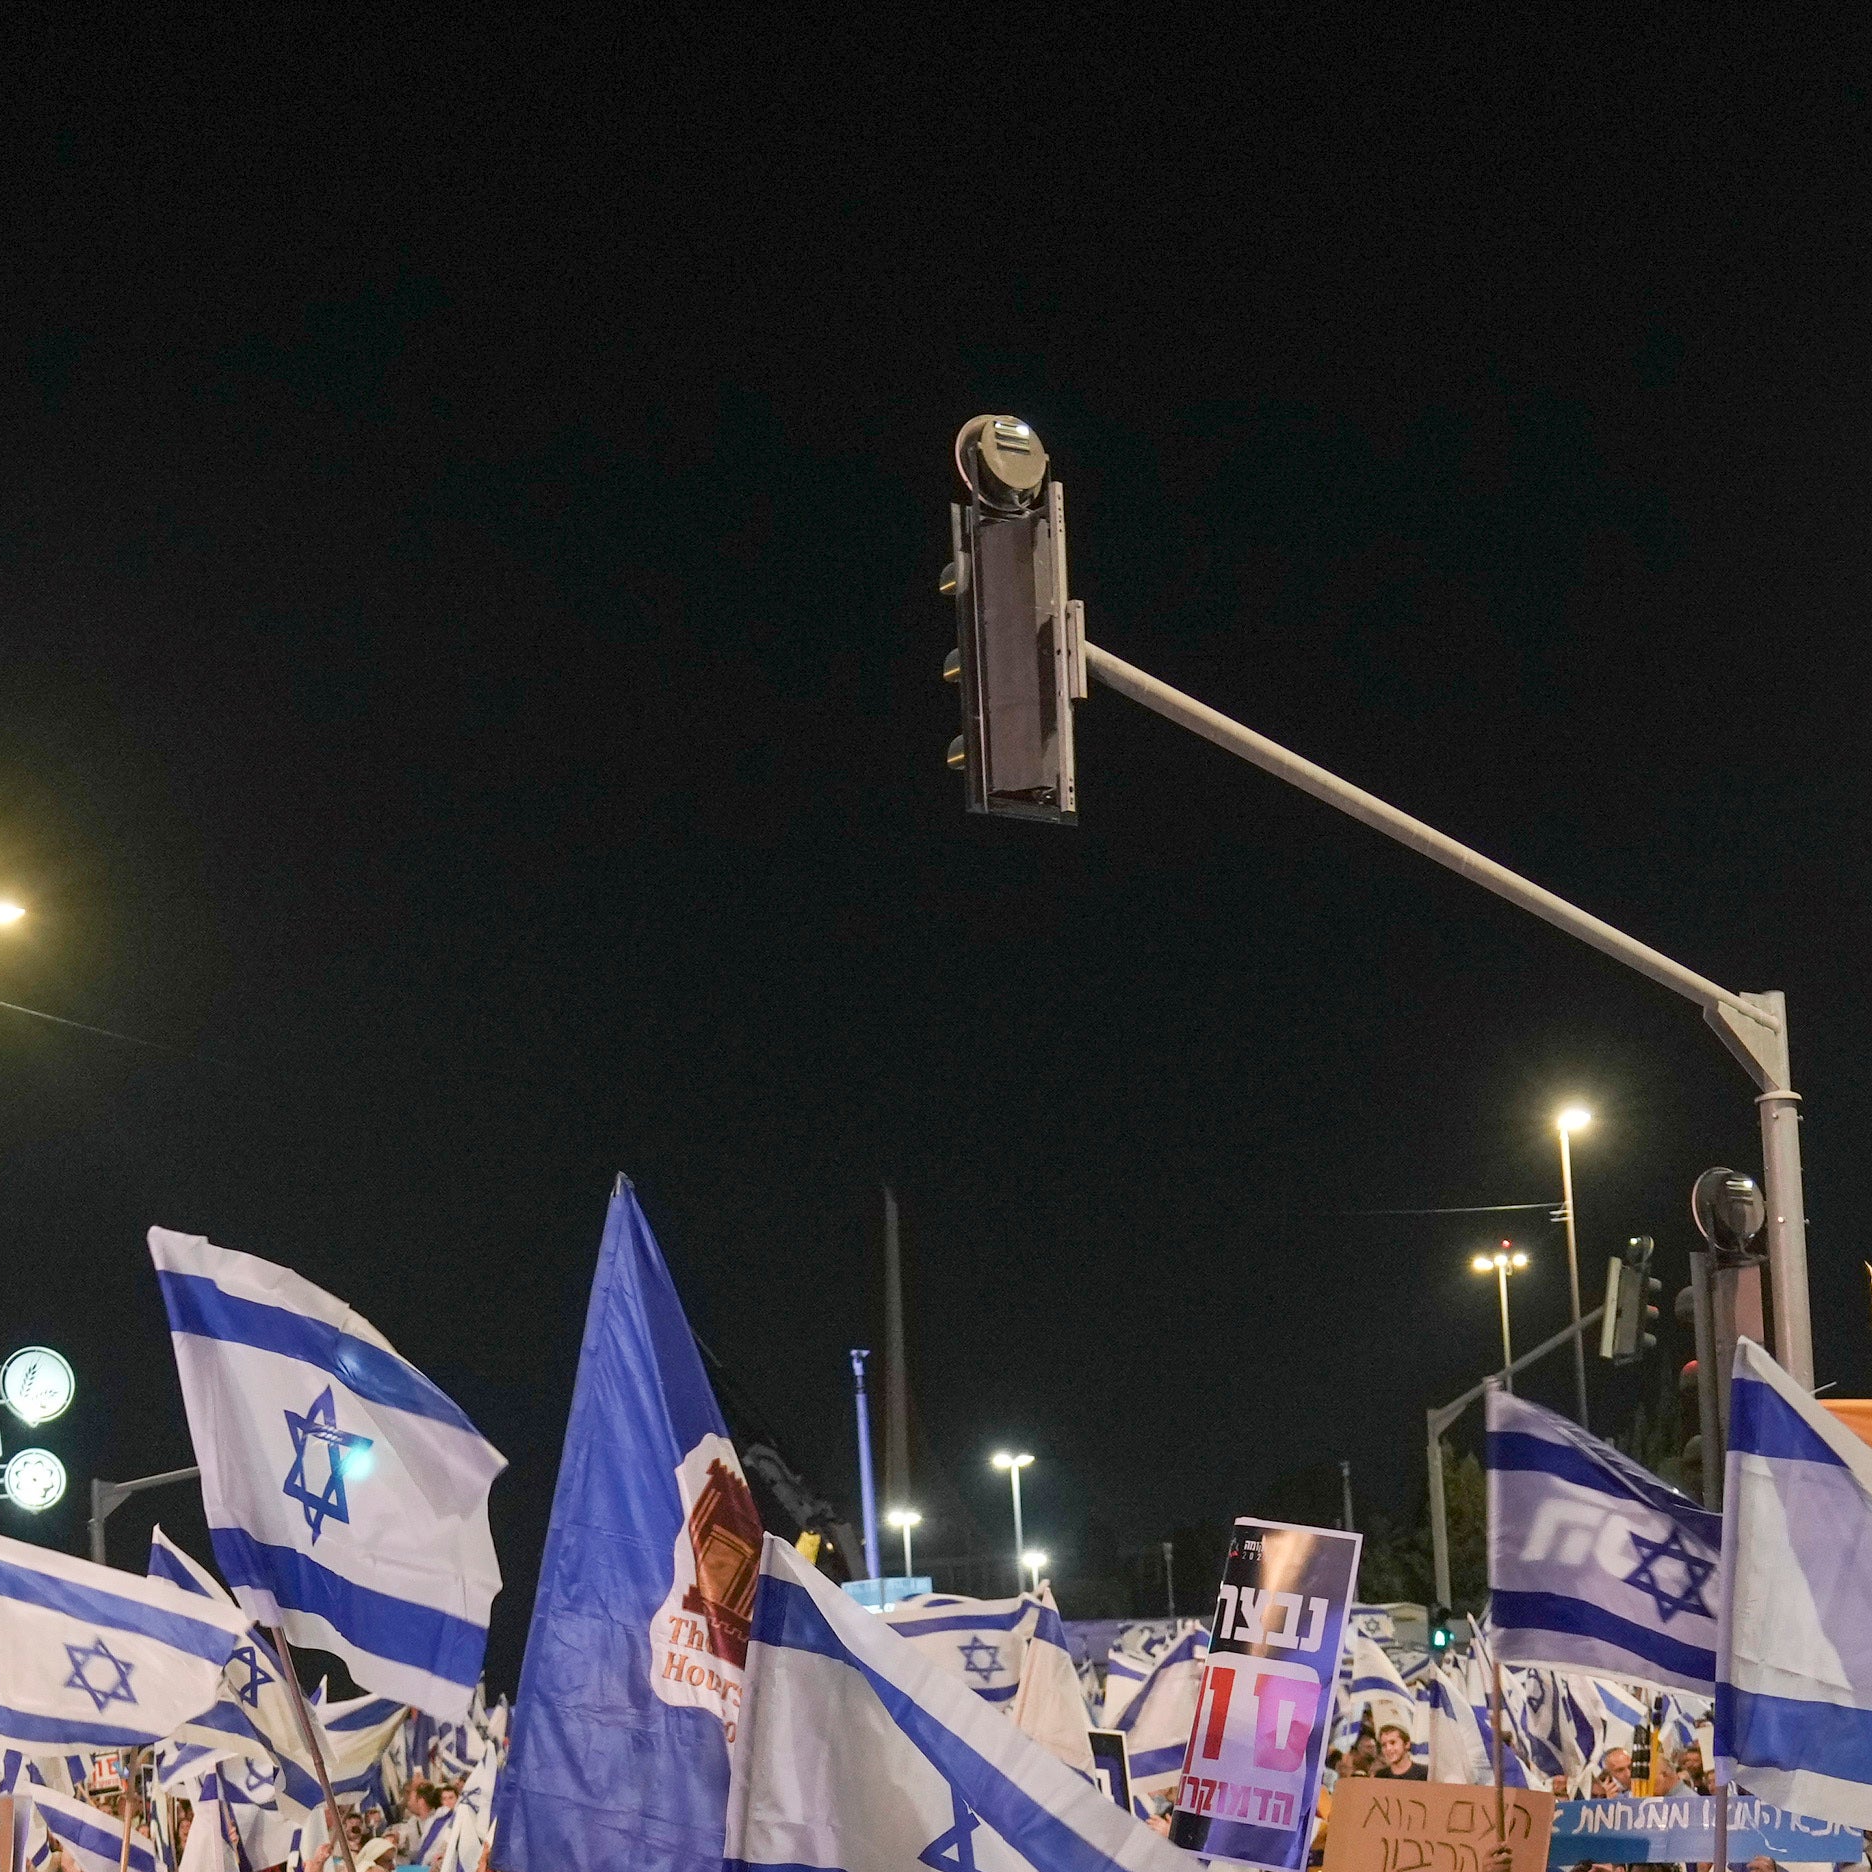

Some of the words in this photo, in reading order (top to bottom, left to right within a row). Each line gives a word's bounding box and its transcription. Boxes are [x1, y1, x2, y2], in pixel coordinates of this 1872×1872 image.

[1241, 1550, 1263, 1561] 202
[1218, 1584, 1329, 1653] נבצר
[1183, 1665, 1323, 1775] סו
[1175, 1775, 1295, 1826] הדמוקר
[1363, 1796, 1427, 1832] הוא
